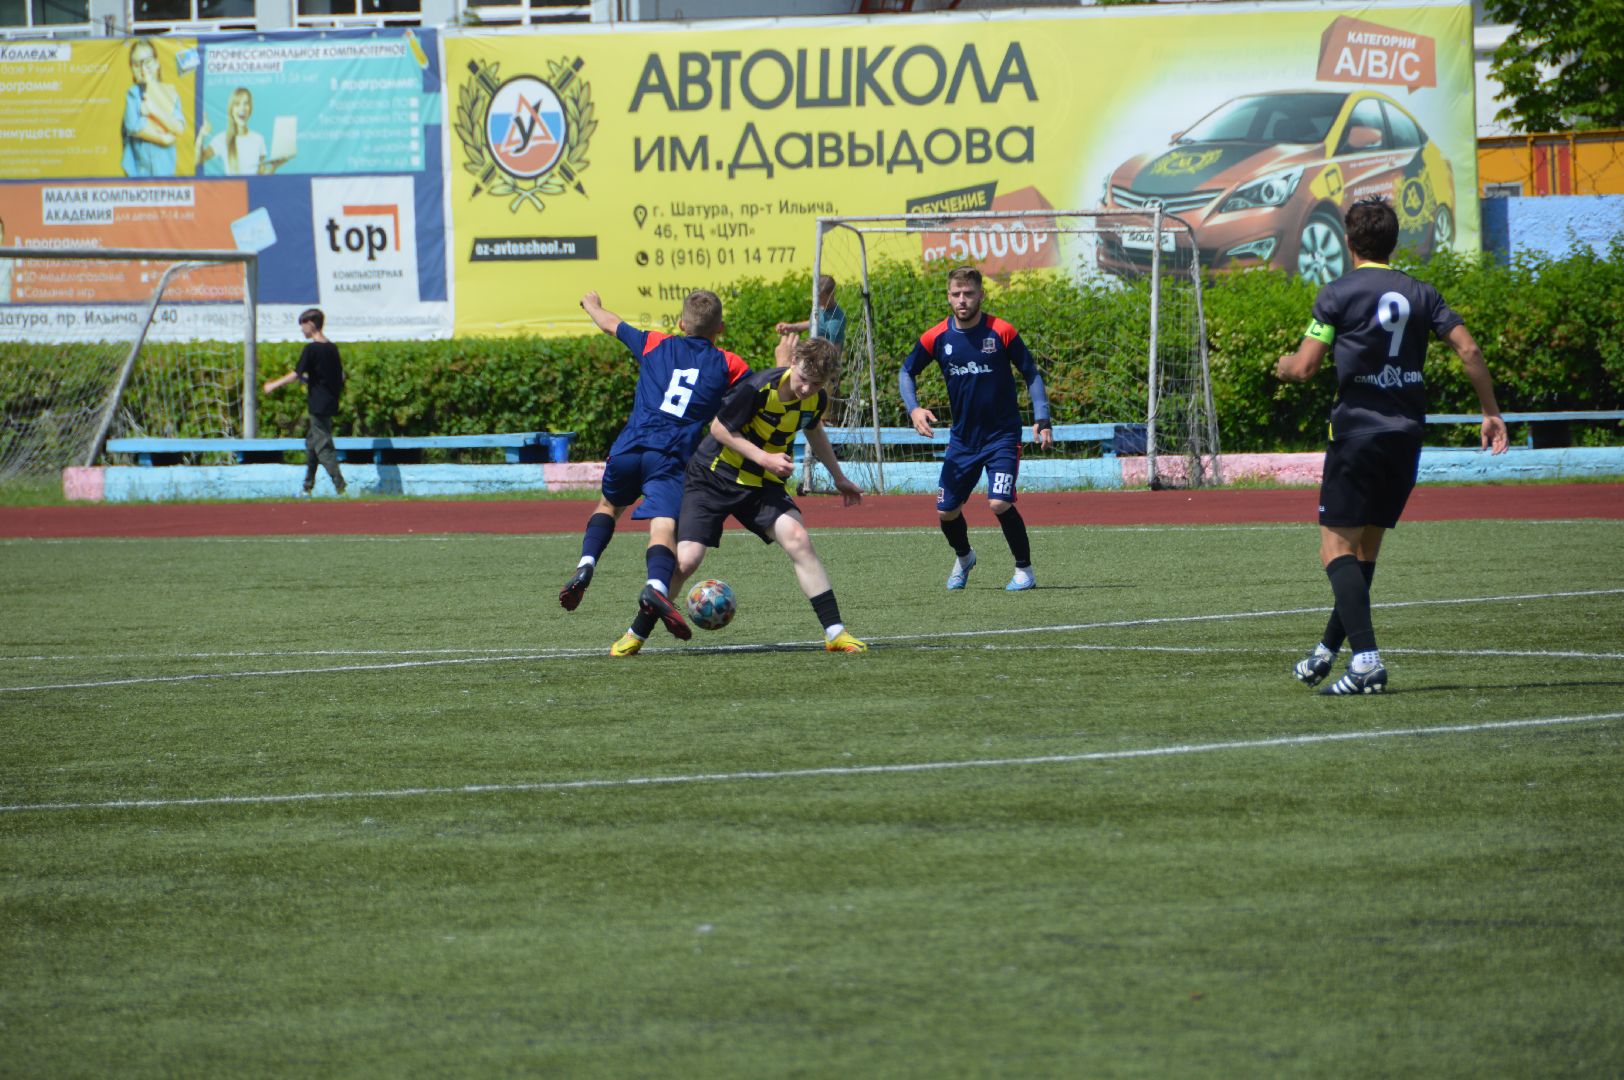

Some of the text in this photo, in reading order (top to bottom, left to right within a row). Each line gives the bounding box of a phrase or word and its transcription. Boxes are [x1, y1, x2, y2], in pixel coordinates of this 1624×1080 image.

[1347, 31, 1416, 49] КАТЕГОРИИ
[1, 46, 57, 60] Колледж
[208, 44, 405, 60] ПРОФЕССИОНАЛЬНОЕ КОМПЬЮТЕРНОЕ
[208, 61, 281, 72] ОБРАЗОВАНИЕ
[628, 42, 1039, 113] АВТОШКОЛА
[45, 188, 191, 203] МАЛАЯ КОМПЬЮТЕРНАЯ
[911, 190, 987, 213] ОБУЧЕНИЕ
[45, 209, 113, 223] АКАДЕМИЯ
[653, 199, 838, 223] г. Шатура, пр-т Ильича,
[325, 217, 387, 260] top
[654, 222, 755, 240] 46, ТЦ «ЦУП»
[475, 240, 576, 256] oz-avtoschool.ru
[654, 246, 796, 269] 8 (916) 01 14 777
[333, 270, 403, 280] КОМПЬЮТЕРНАЯ
[334, 284, 381, 293] АКАДЕМИЯ
[1378, 291, 1410, 357] 9
[659, 367, 700, 418] 6
[993, 472, 1013, 495] 88
